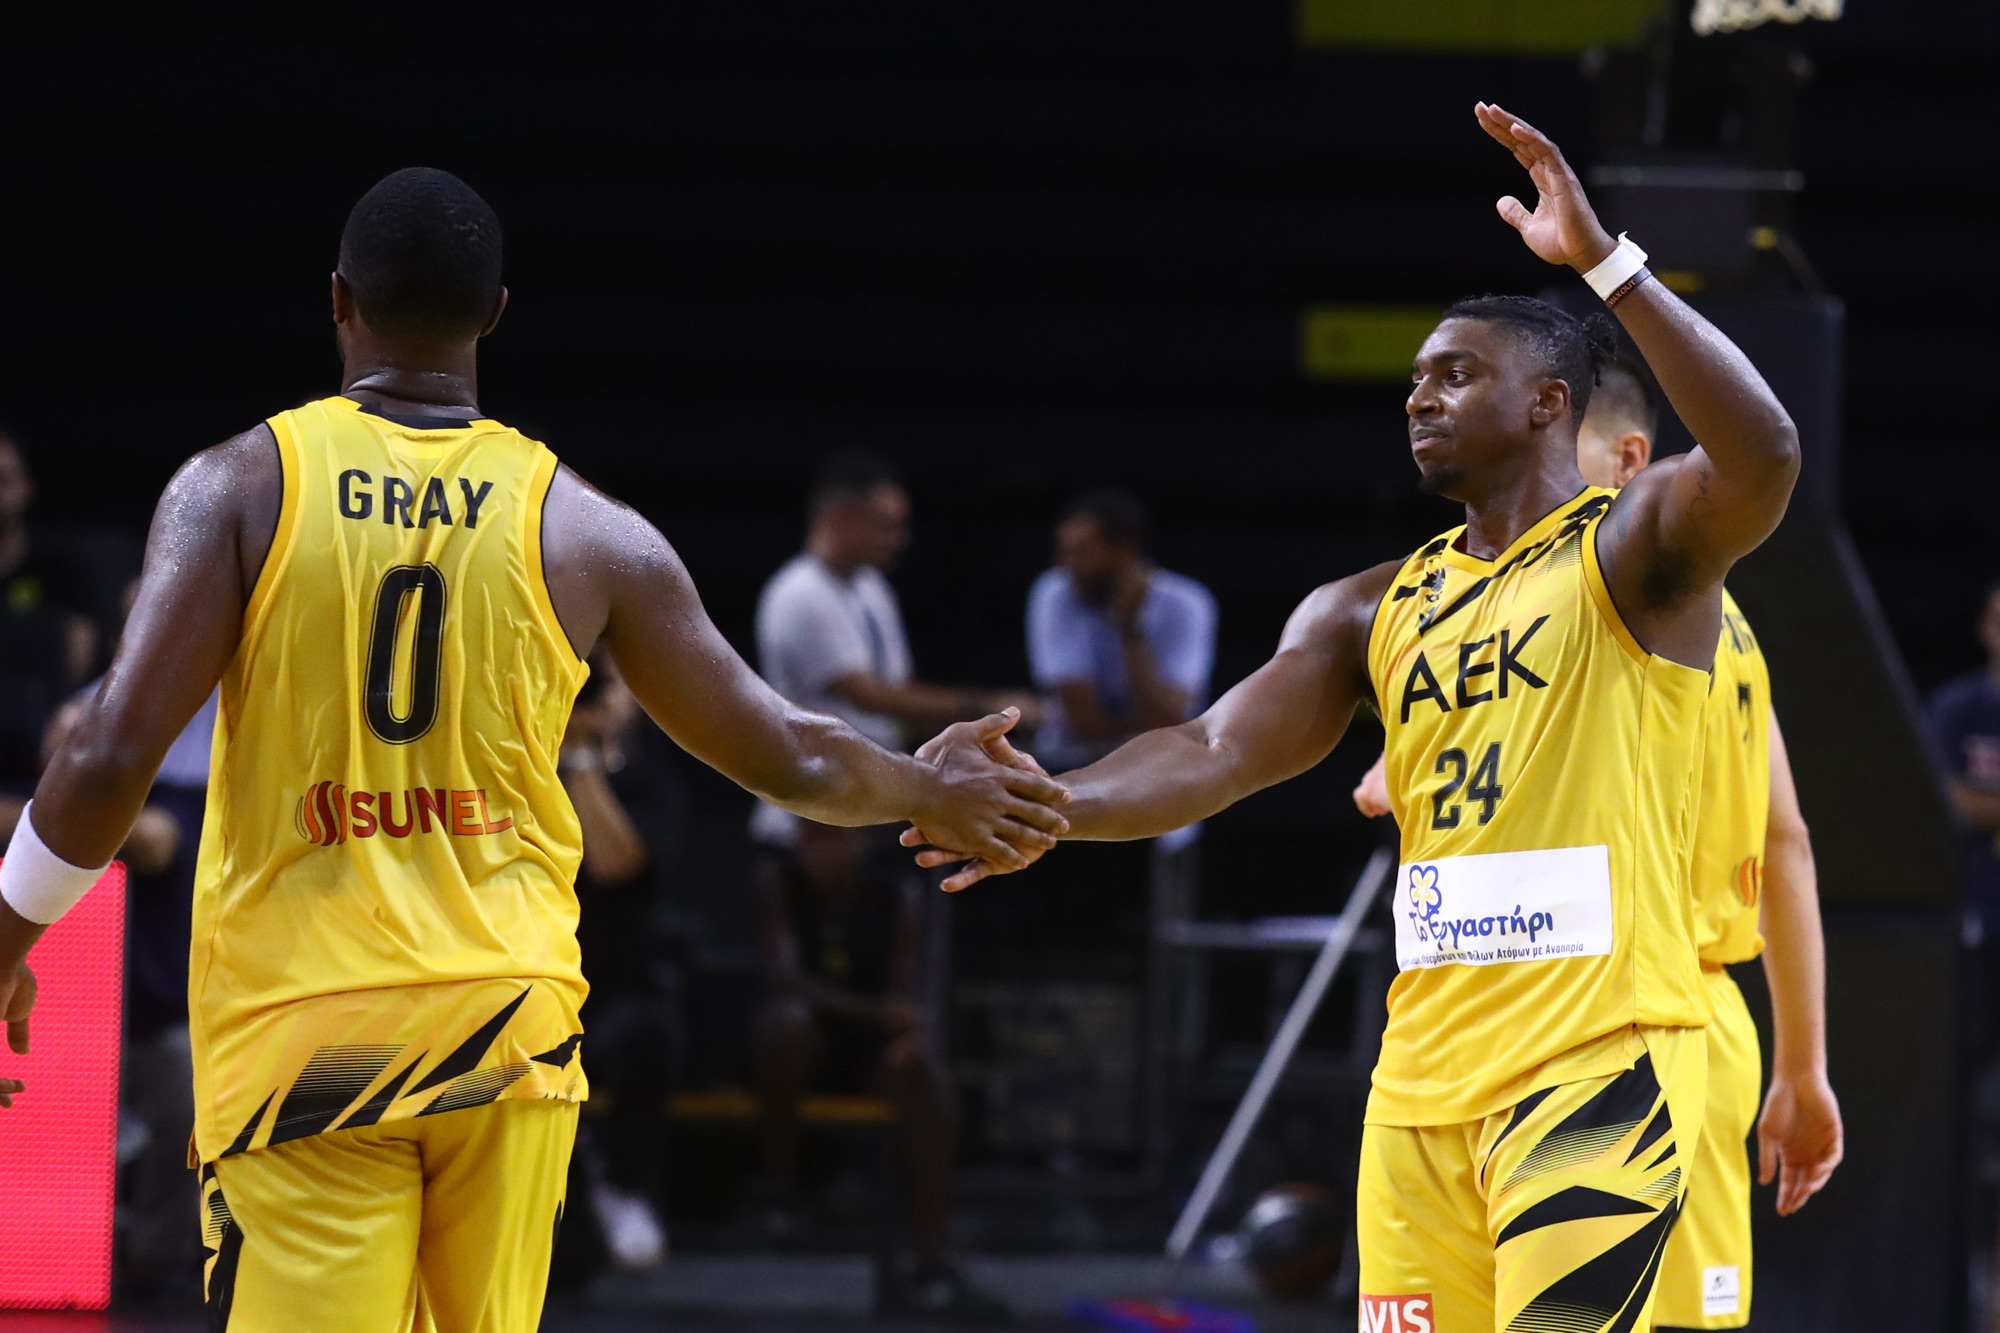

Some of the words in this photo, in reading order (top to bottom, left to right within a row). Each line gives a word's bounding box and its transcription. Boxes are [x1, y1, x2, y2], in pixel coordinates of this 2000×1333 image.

[338, 469, 494, 529] GRAY
[363, 561, 447, 745] 0
[1400, 614, 1550, 725] AEK
[350, 786, 513, 838] SUNEL
[1431, 741, 1503, 830] 24
[1497, 946, 1530, 960] Ατόμων
[1533, 945, 1543, 958] με
[1360, 1299, 1431, 1333] AVIS
